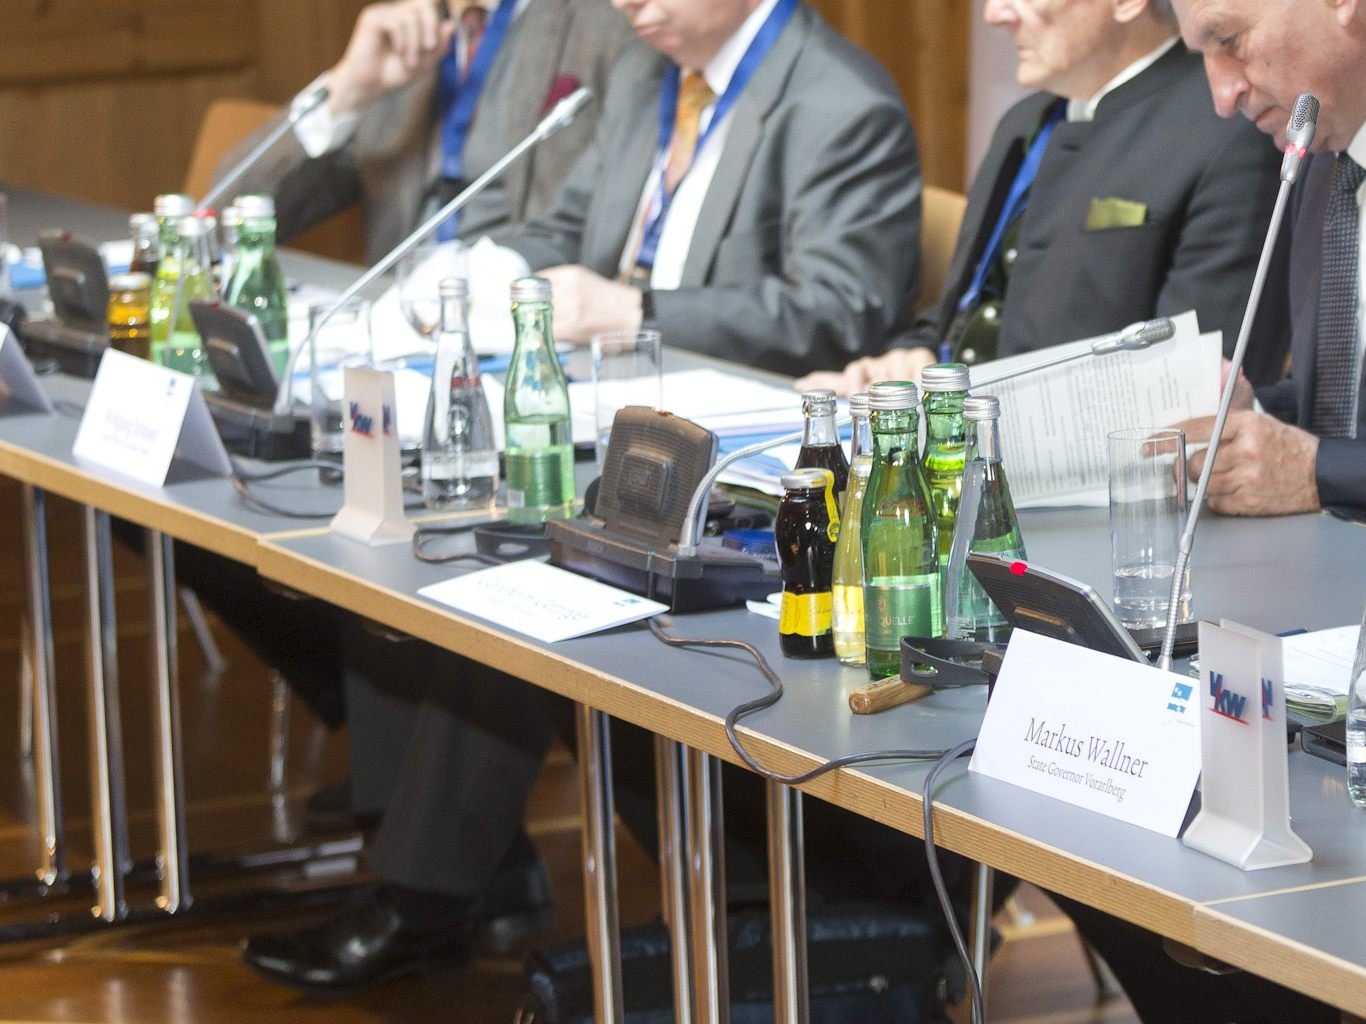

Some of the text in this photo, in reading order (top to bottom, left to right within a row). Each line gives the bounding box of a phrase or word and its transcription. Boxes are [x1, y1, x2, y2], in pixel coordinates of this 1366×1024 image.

[1024, 717, 1148, 778] Markus Wallner
[1027, 755, 1126, 803] State Governor Vorarlberg
